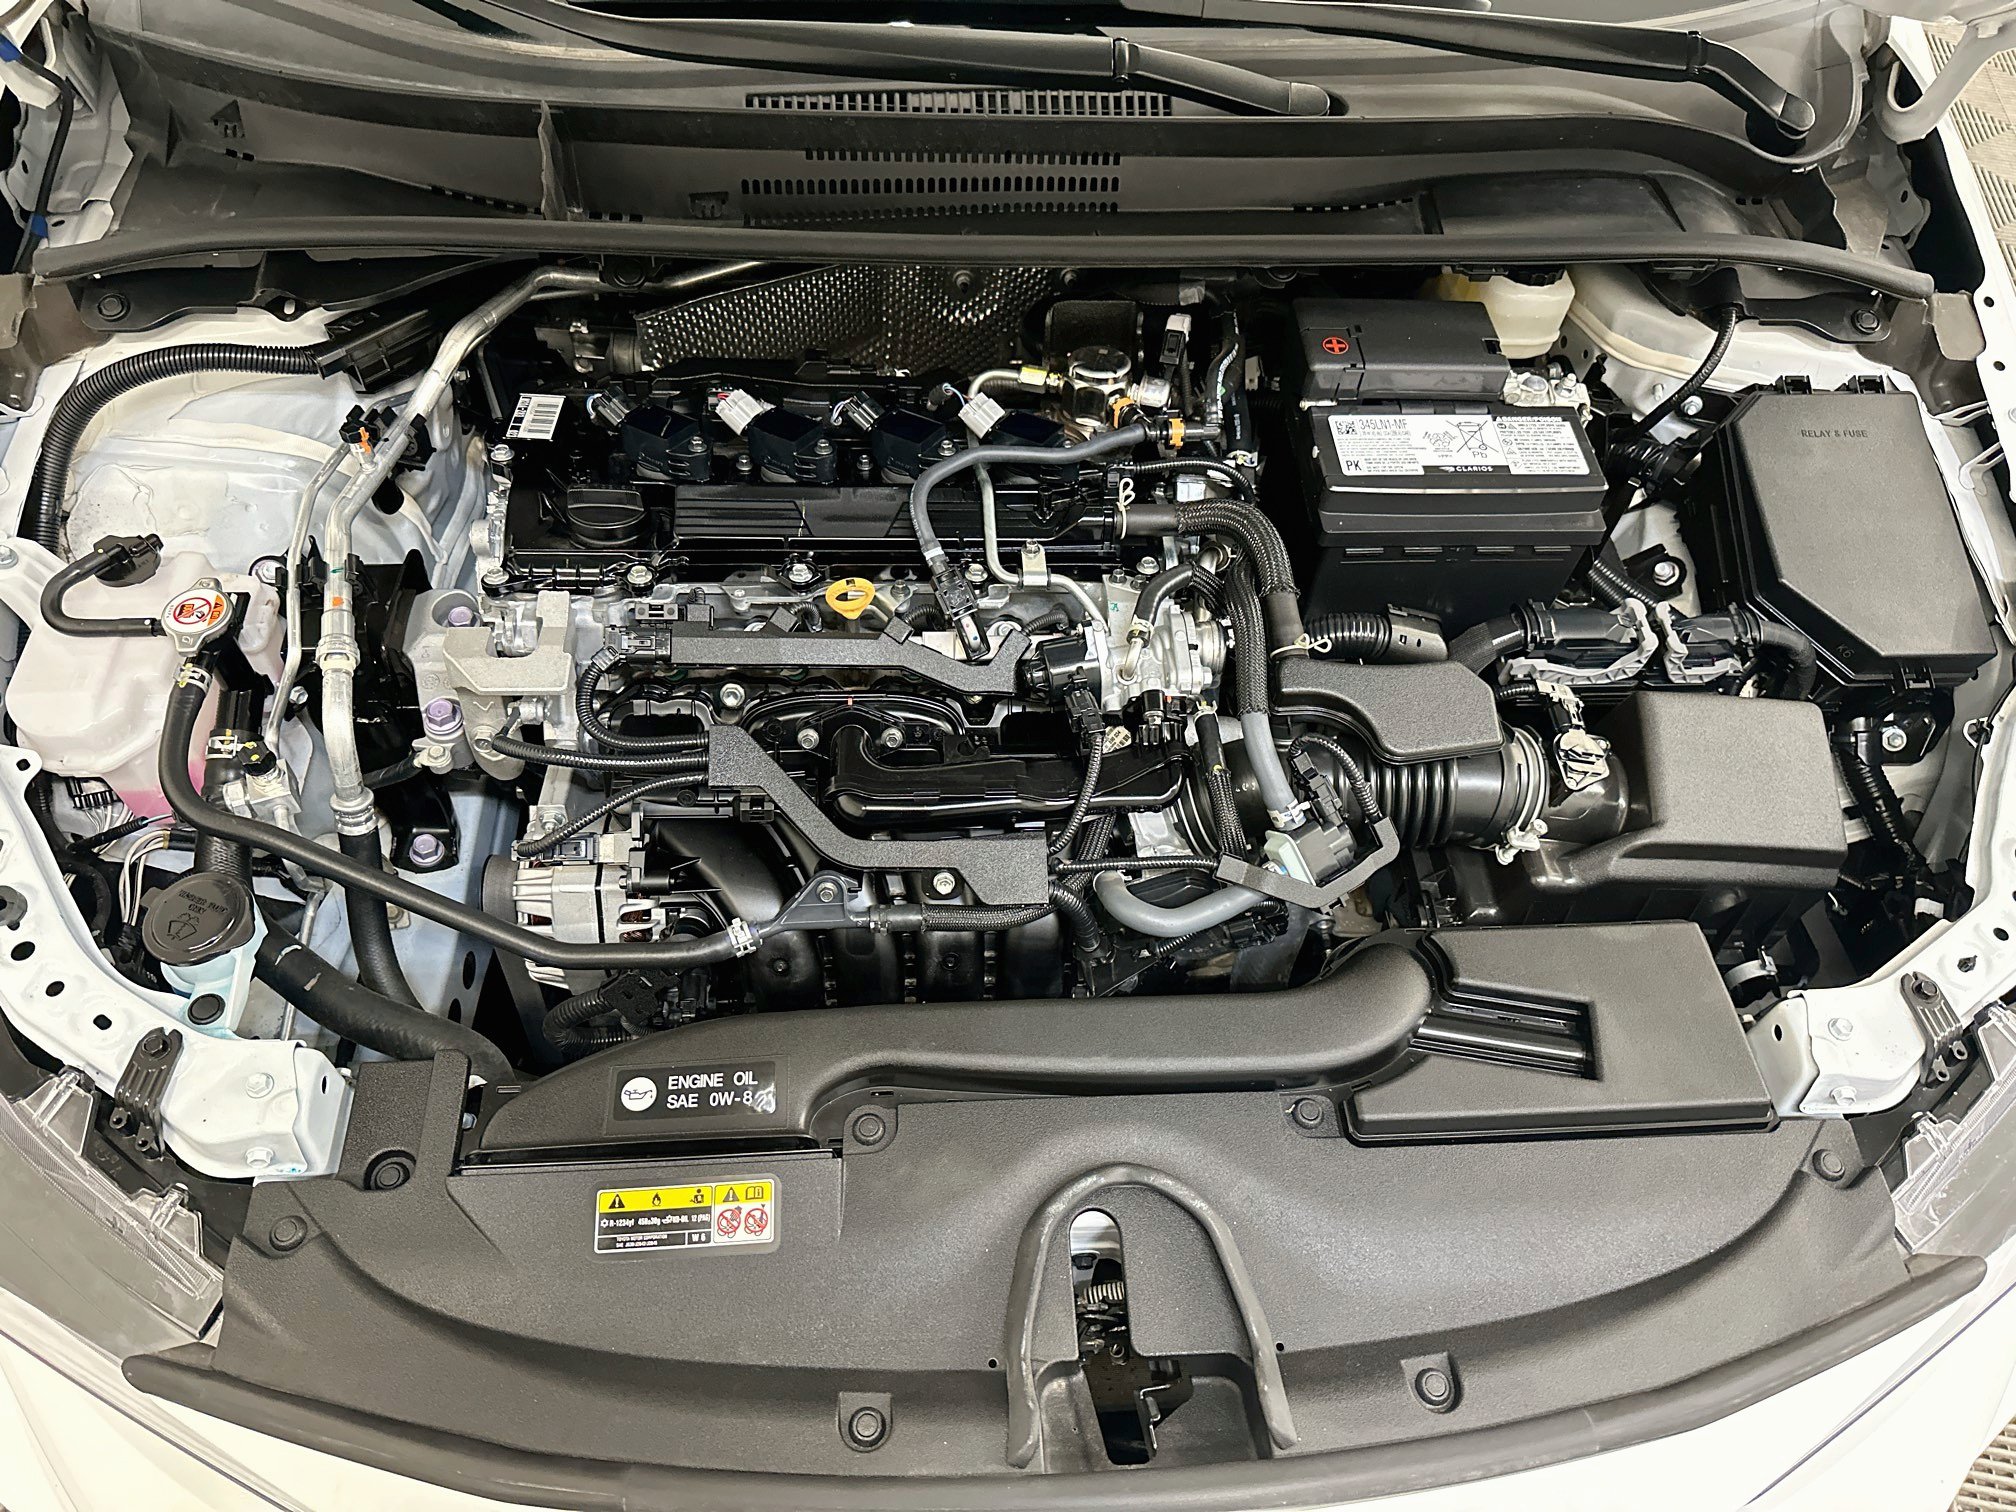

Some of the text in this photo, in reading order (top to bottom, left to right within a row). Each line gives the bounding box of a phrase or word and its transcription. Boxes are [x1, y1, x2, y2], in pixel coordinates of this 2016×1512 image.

[1360, 419, 1407, 430] 345LN1-MF
[1801, 429, 1868, 438] RELAY & FUSE
[1345, 460, 1362, 471] PK
[668, 1071, 758, 1090] ENGINE OIL
[666, 1090, 753, 1110] SAE 0W-8
[691, 1233, 706, 1242] W 6
